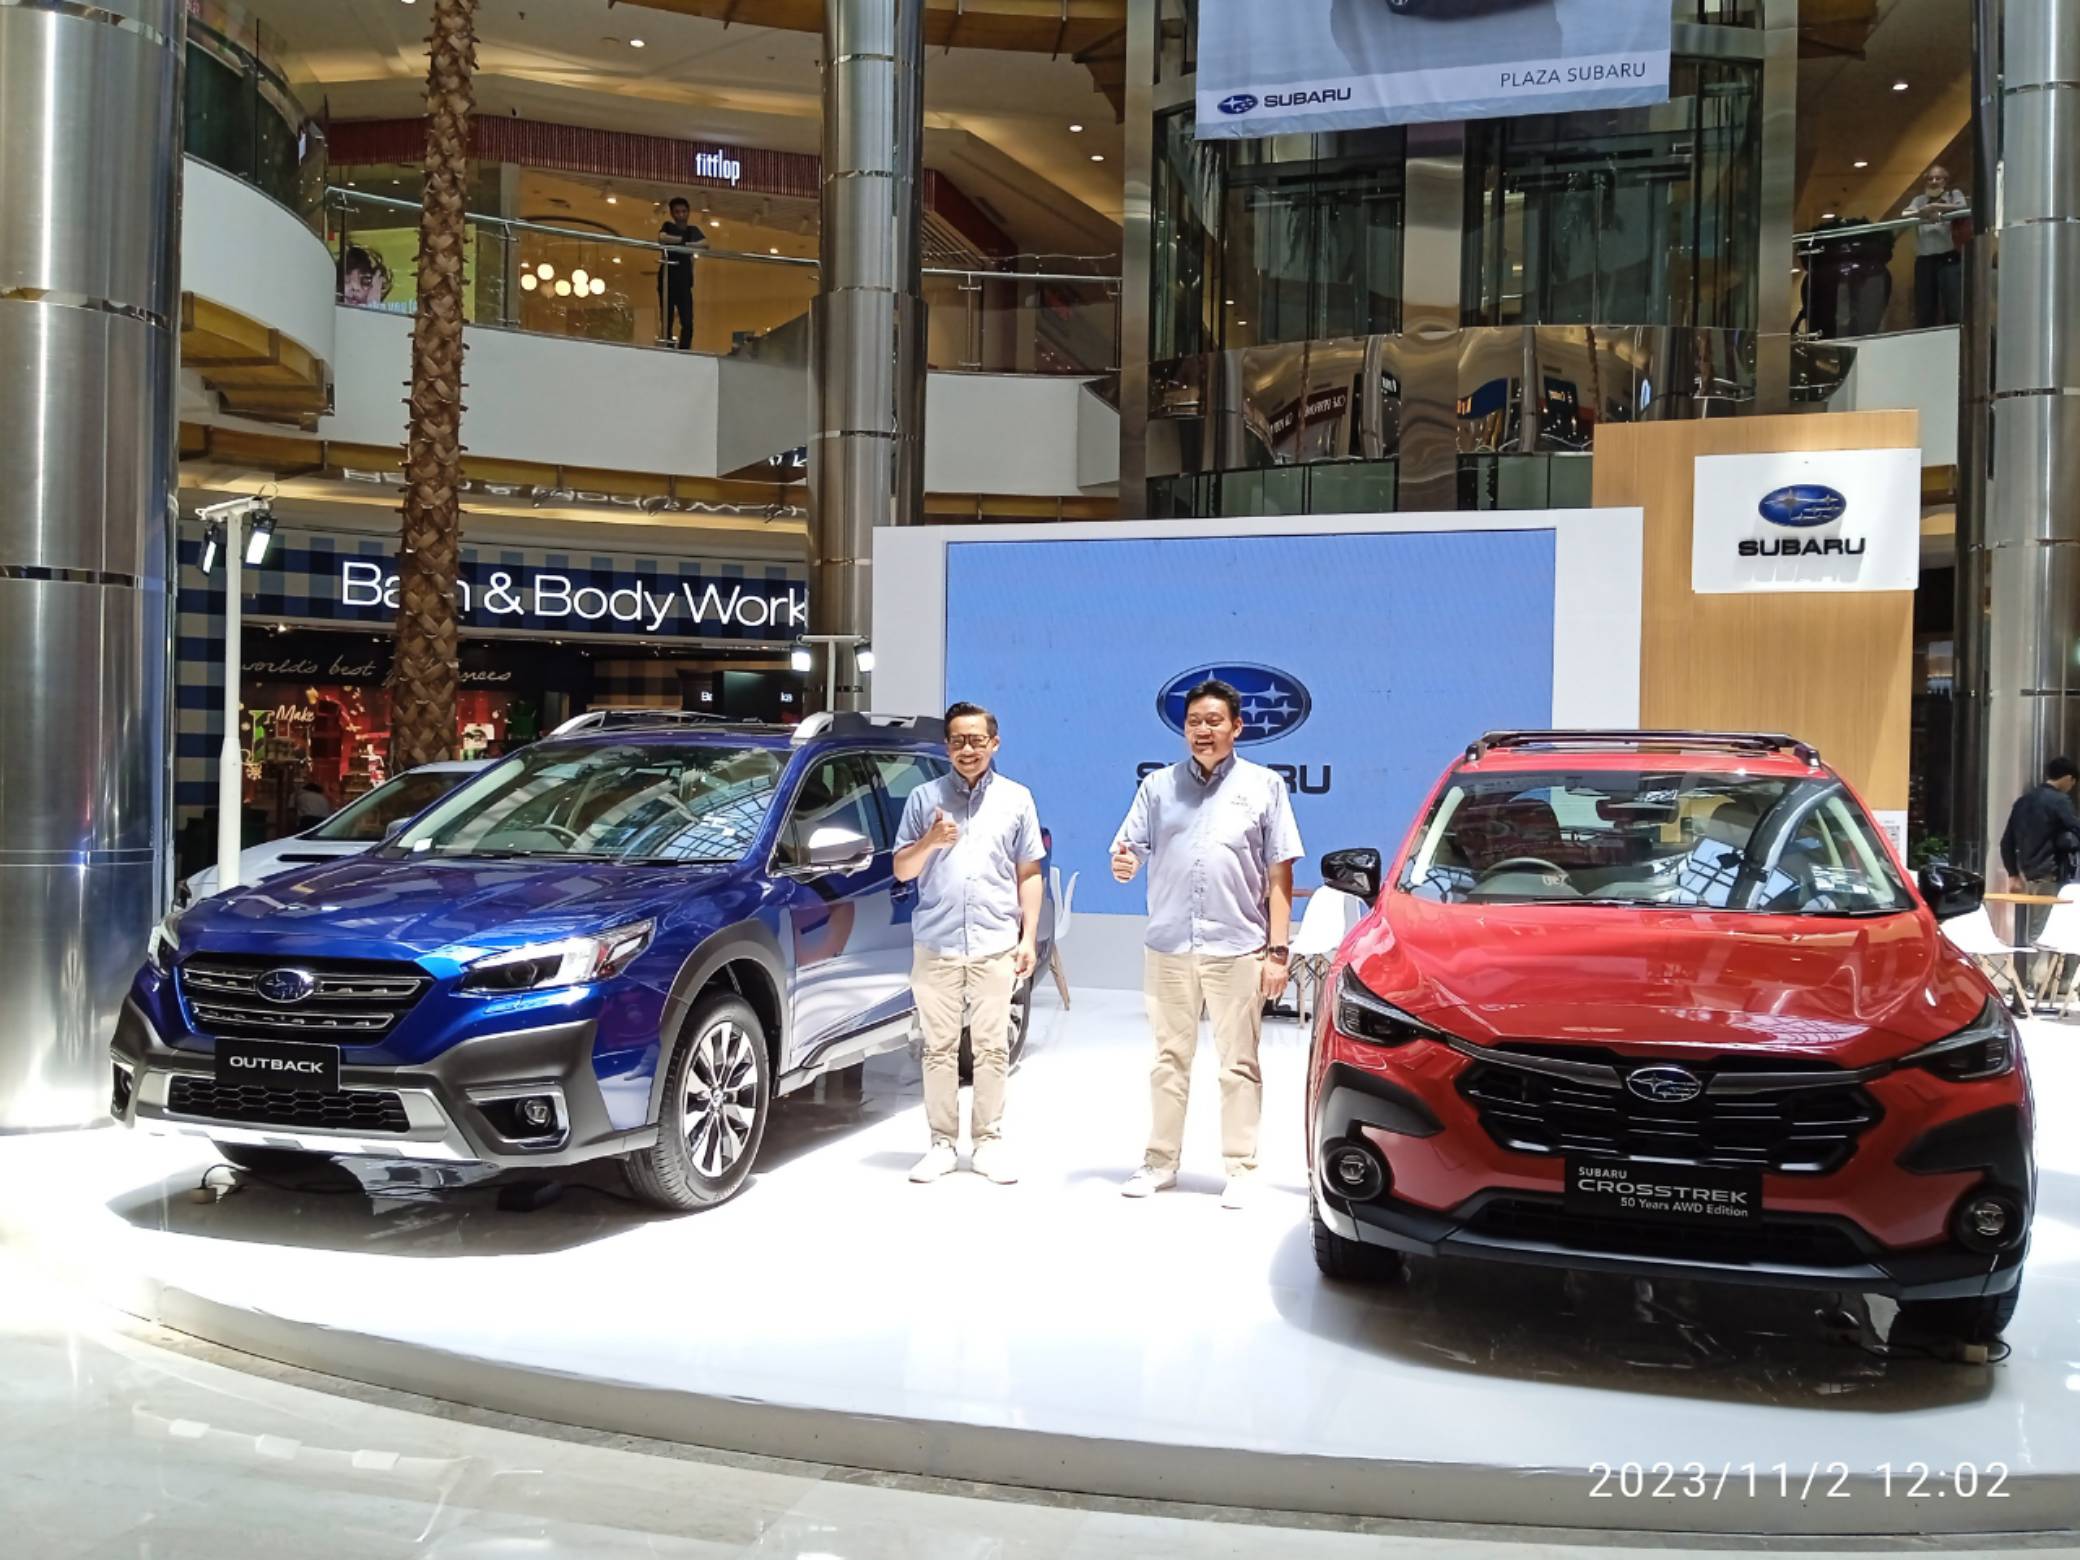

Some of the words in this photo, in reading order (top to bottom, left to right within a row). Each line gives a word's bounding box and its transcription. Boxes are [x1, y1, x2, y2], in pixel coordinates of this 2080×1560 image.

[1501, 69, 1561, 88] PLAZA
[1567, 62, 1646, 82] SUBARU
[1264, 88, 1352, 108] SUBARU
[695, 149, 740, 186] fitflop
[1738, 537, 1866, 557] SUBARU
[342, 560, 471, 613] Ba
[483, 571, 525, 616] &
[534, 574, 675, 632] Body
[329, 654, 377, 676] best
[229, 1055, 324, 1074] OUTBACK
[1578, 1166, 1628, 1179] SUBARU
[1577, 1179, 1748, 1204] CROSSTREK
[1621, 1197, 1636, 1207] 50
[1639, 1198, 1670, 1211] Years
[1672, 1202, 1703, 1214] AWD
[1706, 1204, 1748, 1217] Edition
